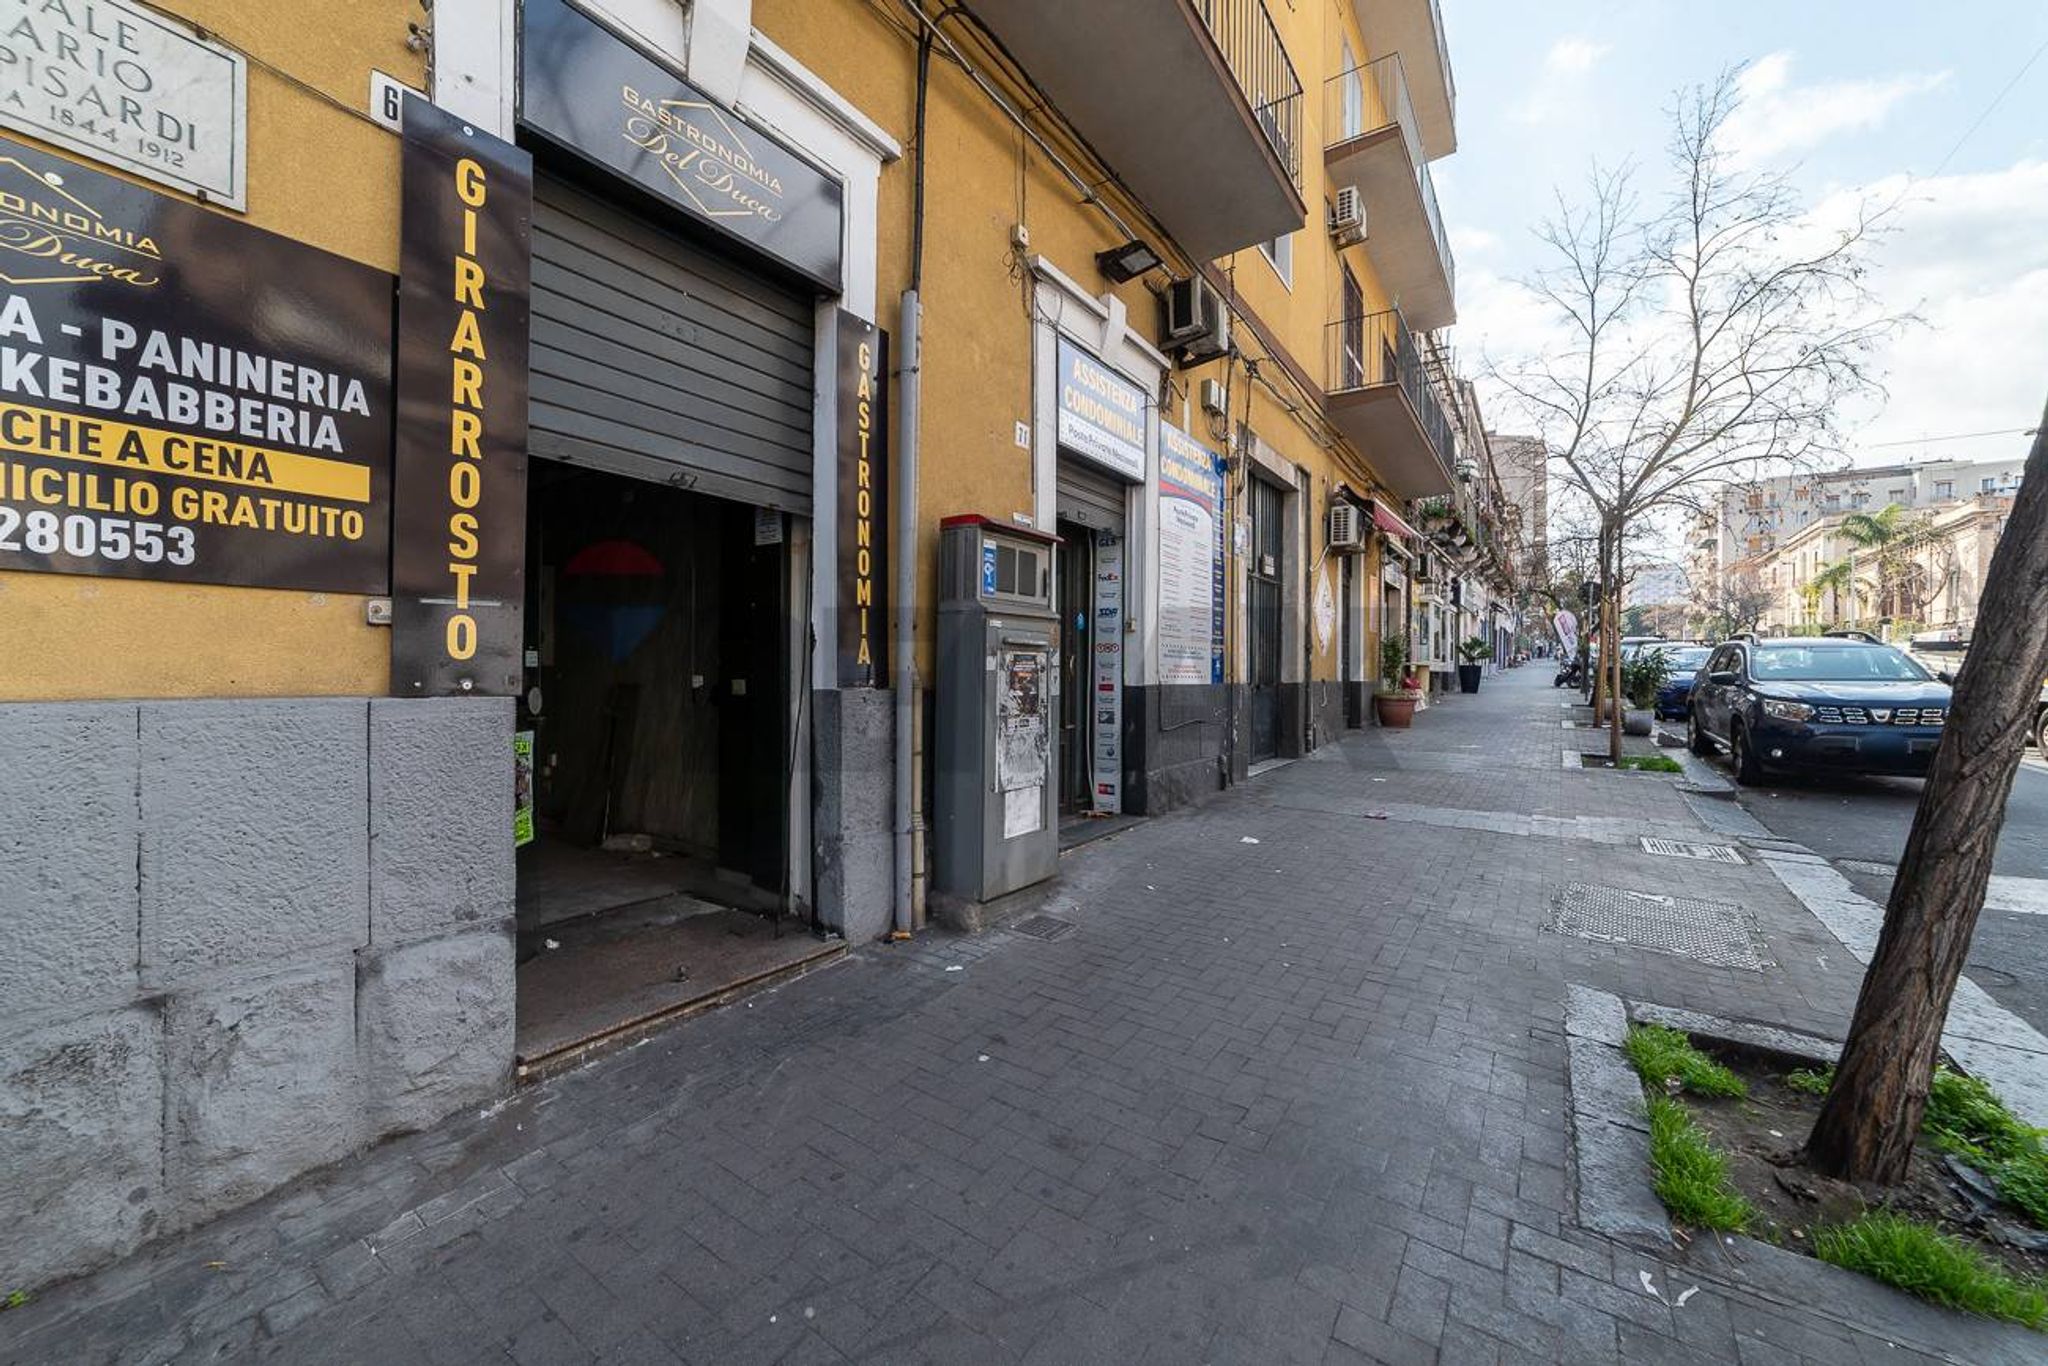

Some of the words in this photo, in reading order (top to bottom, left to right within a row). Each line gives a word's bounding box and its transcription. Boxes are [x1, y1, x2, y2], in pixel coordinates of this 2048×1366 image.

[50, 105, 119, 143] 1844
[138, 138, 184, 168] 1912
[384, 85, 398, 121] 6
[623, 86, 783, 195] GASTRONOMIA
[622, 117, 700, 170] Del
[695, 158, 783, 222] Duca
[0, 219, 160, 286] Duca
[2, 346, 343, 453] KEBABBERIA
[102, 317, 371, 417] PANINERIA
[1073, 359, 1138, 415] ASSISTENZA
[2, 409, 102, 458] CHE
[116, 429, 149, 465] A
[163, 437, 273, 484] CENA
[446, 158, 487, 661] GIRARROSTO
[1064, 385, 1144, 448] CONDOMINIALE
[0, 461, 159, 517] ICILIO
[172, 486, 364, 540] GRATUITO
[856, 342, 872, 665] GASTRONOMIA
